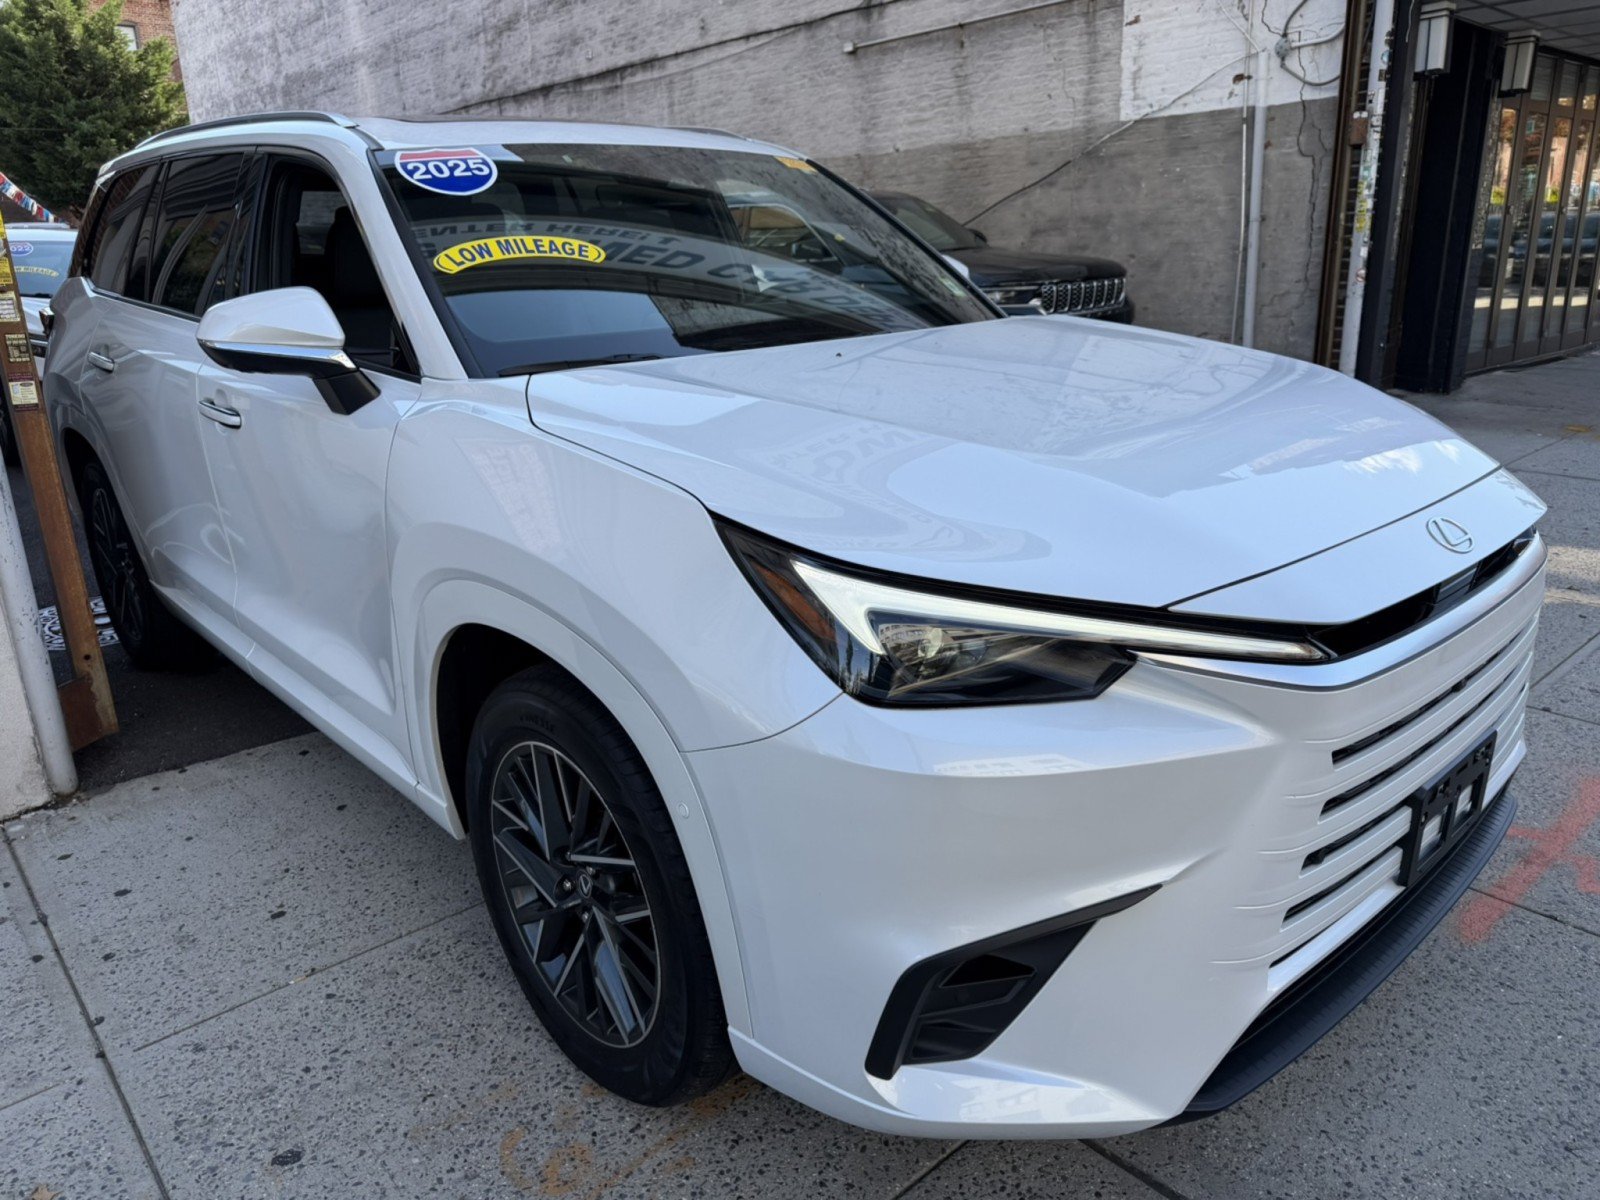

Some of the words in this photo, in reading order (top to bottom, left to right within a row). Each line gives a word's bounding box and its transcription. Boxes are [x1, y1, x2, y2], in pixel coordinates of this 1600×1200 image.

[407, 159, 490, 180] 2025
[444, 242, 494, 267] LOW
[495, 238, 589, 259] MILEAGE
